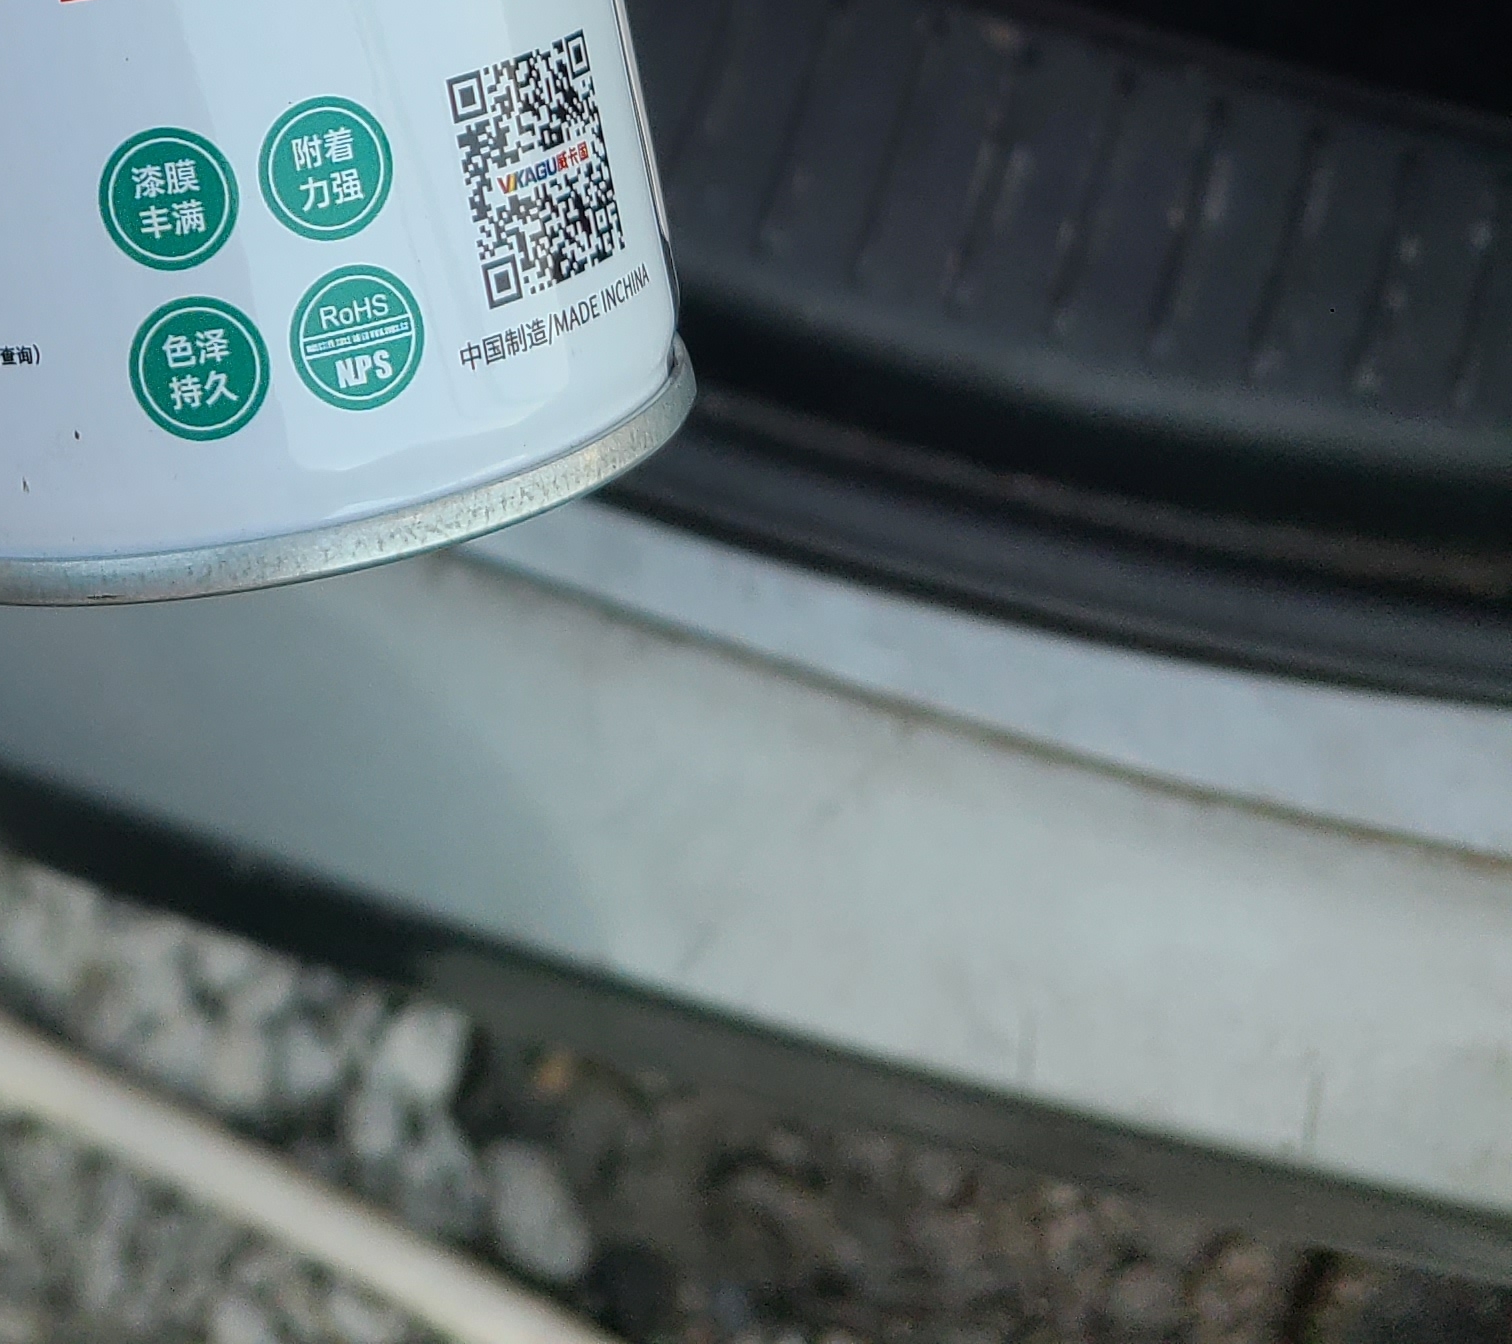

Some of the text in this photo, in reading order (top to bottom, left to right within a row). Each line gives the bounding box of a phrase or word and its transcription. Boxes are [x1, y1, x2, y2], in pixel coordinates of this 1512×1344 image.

[291, 127, 356, 172] 附着
[130, 159, 201, 201] 漆膜
[300, 173, 364, 213] 力强
[140, 200, 207, 240] 丰满
[319, 294, 389, 329] RoHS
[161, 328, 229, 368] 色泽
[335, 350, 393, 389] NPS
[171, 371, 238, 411] 持久
